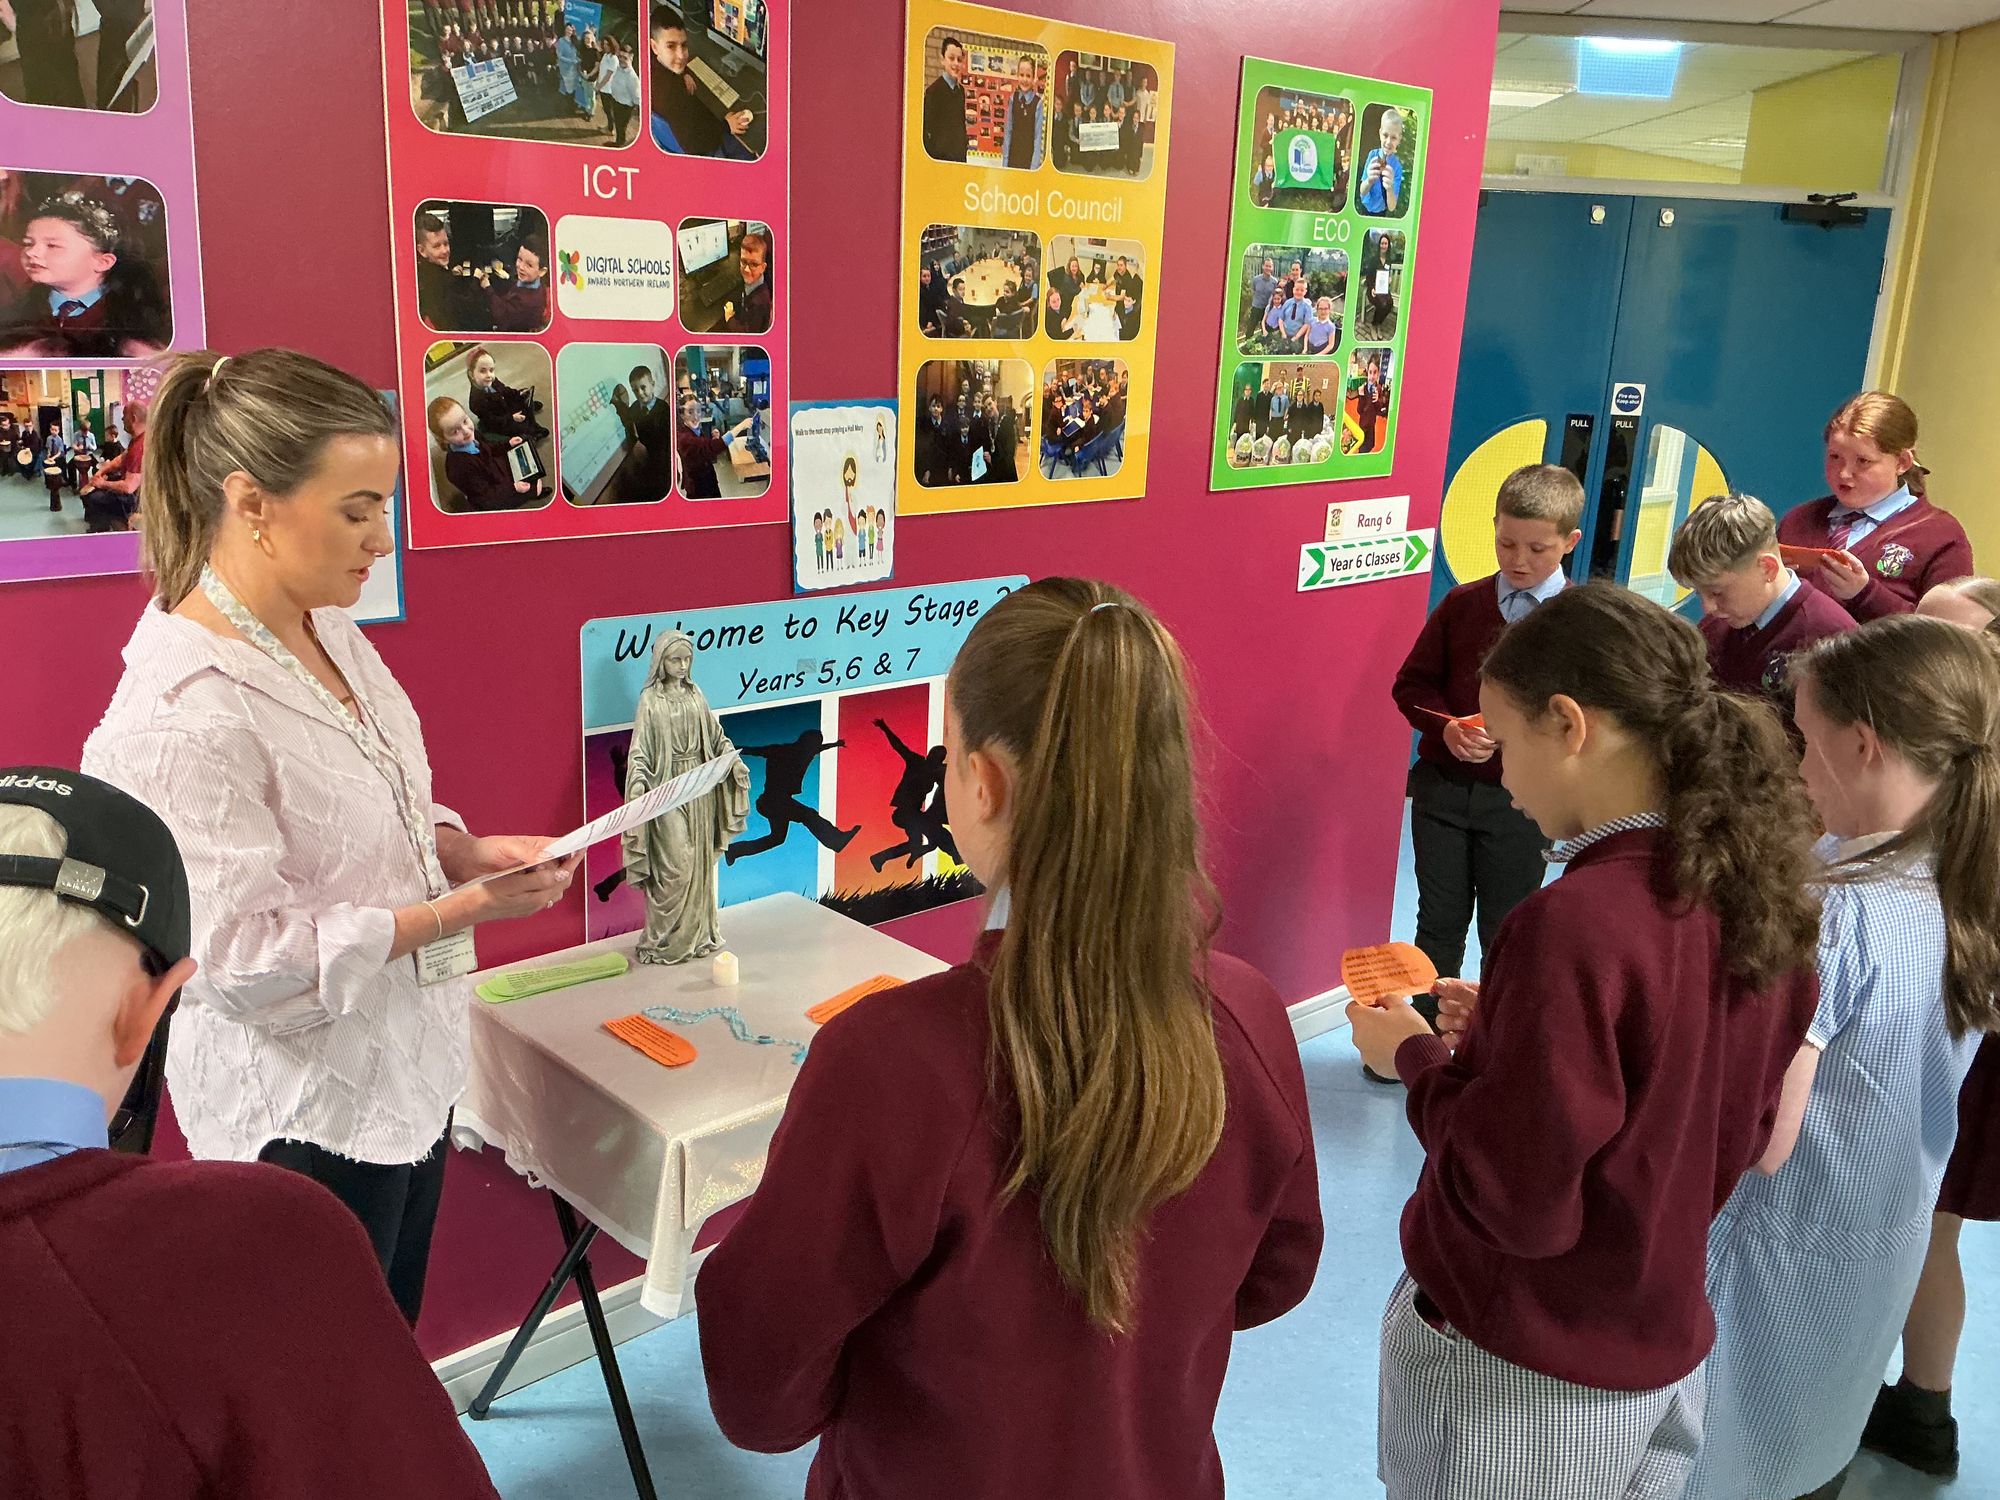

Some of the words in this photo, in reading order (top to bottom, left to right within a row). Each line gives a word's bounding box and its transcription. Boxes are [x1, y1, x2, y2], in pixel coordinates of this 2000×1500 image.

[583, 163, 640, 200] ICT
[964, 182, 1040, 216] School
[1047, 190, 1122, 223] Council
[1313, 217, 1350, 242] ECO
[586, 256, 624, 274] DIGITAL
[627, 258, 671, 275] SCHOOLS
[587, 277, 611, 286] AWARDS
[613, 278, 645, 288] NORTHERN
[646, 279, 671, 289] IRELAND
[1570, 419, 1589, 428] PULL
[1615, 421, 1634, 429] PULL
[1357, 513, 1382, 532] Rang
[1385, 511, 1392, 525] 6
[1330, 558, 1353, 572] Year
[1356, 554, 1362, 568] 6
[1365, 552, 1401, 567] Classes
[614, 621, 764, 662] Wome
[784, 612, 818, 639] to
[836, 604, 890, 637] Key
[904, 594, 979, 627] Stage
[737, 668, 806, 700] Years
[817, 656, 863, 686] 5,6
[873, 652, 892, 676] &
[906, 647, 921, 671] 7
[0, 774, 73, 796] didas
